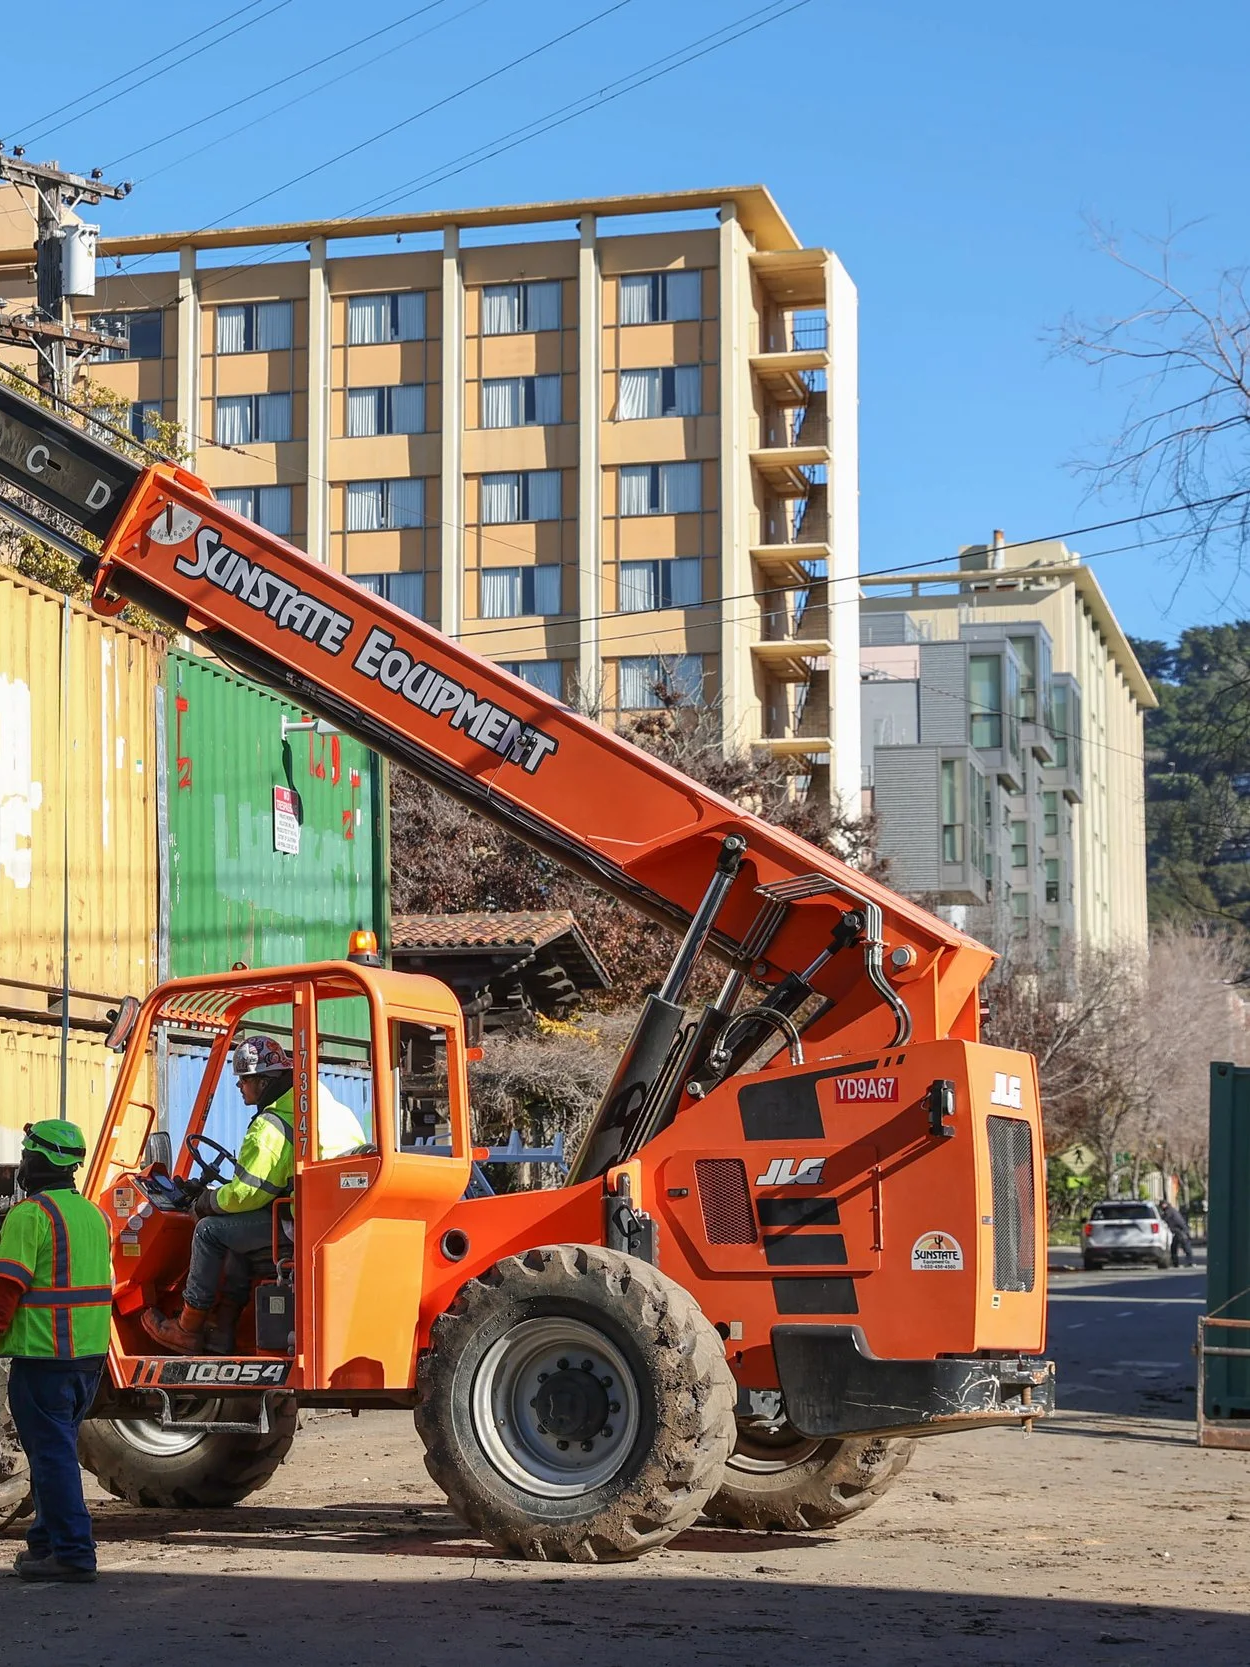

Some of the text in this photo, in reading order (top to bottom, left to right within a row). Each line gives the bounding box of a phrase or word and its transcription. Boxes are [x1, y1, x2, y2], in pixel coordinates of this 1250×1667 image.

[26, 445, 50, 474] C
[85, 479, 111, 510] D
[299, 1029, 308, 1157] 173647
[836, 1078, 895, 1100] YD9A67
[990, 1072, 1022, 1109] JLG
[755, 1157, 825, 1186] JLG
[185, 1364, 285, 1382] 10054
